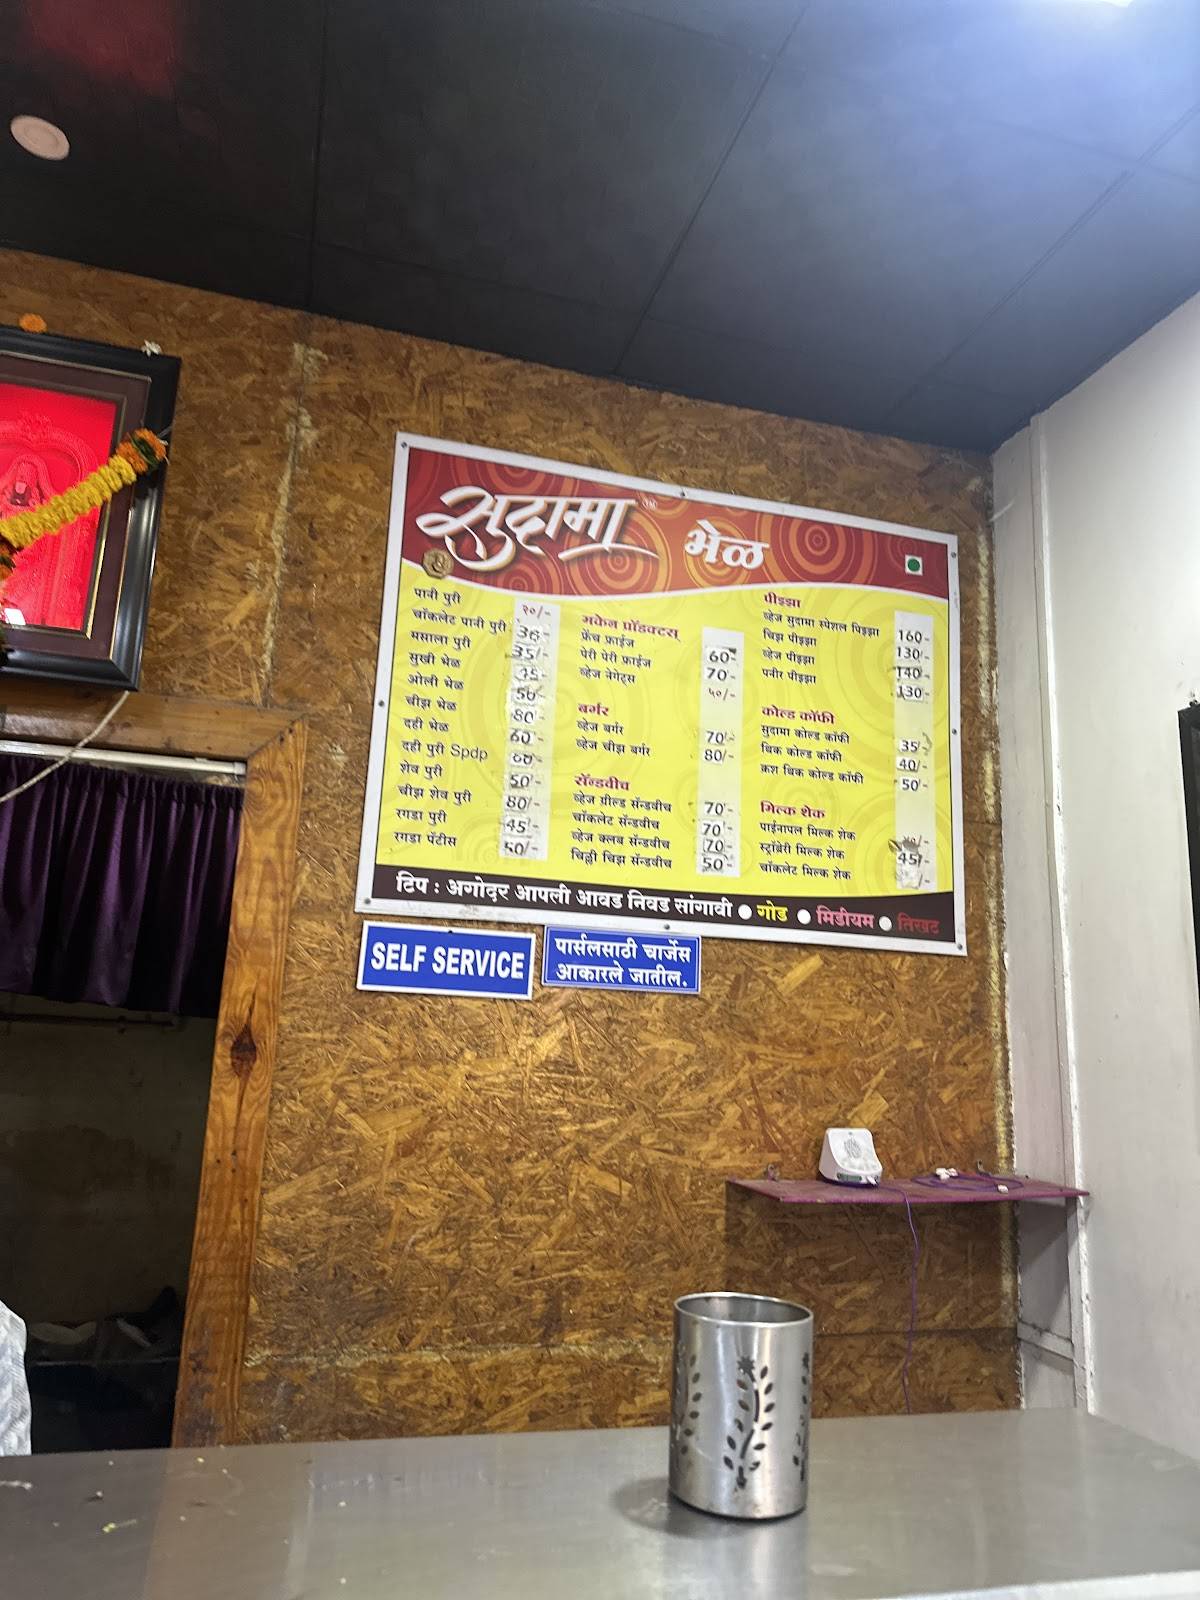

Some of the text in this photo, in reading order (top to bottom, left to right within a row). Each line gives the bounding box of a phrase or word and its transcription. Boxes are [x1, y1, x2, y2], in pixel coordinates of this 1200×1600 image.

[416, 486, 770, 571] सुदामा भेळ
[414, 588, 438, 600] पानी
[443, 592, 461, 607] पुरी
[412, 607, 457, 625] चॉकलेट
[462, 617, 484, 630] पानी
[490, 620, 506, 634] पुरी
[763, 610, 782, 624] व्हेज
[787, 615, 815, 628] सुदामा
[819, 616, 847, 632] स्पेशल
[411, 631, 448, 644] मसाला
[454, 637, 471, 651] पुरी
[409, 652, 435, 667] सुखी
[441, 655, 460, 668] भेळ
[580, 647, 596, 661] पेरी
[601, 649, 617, 663] पेरी
[762, 648, 782, 662] व्हेज
[408, 672, 438, 687] ओली
[444, 676, 464, 690] भेळ
[578, 665, 601, 679] व्हेज
[762, 667, 784, 680] पनीर
[406, 695, 431, 709] चीझ
[437, 698, 457, 711] भेळ
[578, 703, 609, 716] बर्गर
[762, 705, 835, 725] कोल्ड कॉफी
[403, 717, 422, 730] दही
[429, 718, 449, 732] भेळ
[577, 719, 598, 733] व्हेज
[603, 723, 624, 735] बर्गर
[761, 725, 790, 738] सुदामा
[794, 726, 820, 742] कोल्ड
[824, 730, 850, 744] कॉफी
[402, 740, 421, 752] दही
[427, 743, 445, 758] पुरी
[450, 744, 488, 762] Spdp
[576, 737, 734, 762] व्हेज चीझ बर्गर 80/-
[787, 745, 812, 759] कोल्ड
[816, 749, 842, 762] कॉफी
[400, 761, 419, 774] शेव
[425, 765, 442, 779] पुरी
[808, 767, 834, 781] कोल्ड
[839, 770, 864, 785] कॉफी
[398, 784, 423, 800] चीझ
[430, 785, 448, 800] शेव
[454, 790, 471, 805] पुरी
[573, 792, 595, 805] व्हेज
[396, 808, 422, 821] रगडा
[429, 811, 447, 826] पुरी
[572, 810, 613, 826] चॉकलेट
[761, 801, 826, 819] मिल्क शेक
[394, 831, 421, 843] रगडा
[572, 828, 593, 842] व्हेज
[760, 821, 803, 836] पाईनापल
[807, 824, 834, 839] मिल्क
[838, 827, 856, 841] शेक
[796, 843, 822, 858] मिल्क
[827, 846, 845, 861] शेक
[760, 861, 851, 880] चॉकलेट मिल्क शेक
[396, 871, 429, 895] टिप
[447, 876, 510, 902] अगोदर
[515, 883, 573, 905] आपली
[576, 889, 623, 909] आवड
[628, 889, 670, 912] निवड
[674, 895, 732, 917] सांगावी
[757, 900, 788, 923] गोड
[816, 905, 875, 929] मिडीयम
[898, 914, 940, 935] तिखट
[555, 934, 638, 959] पार्सलसाठी
[371, 942, 525, 980] SELF SERVICE
[556, 961, 688, 987] आकारले जातील.
